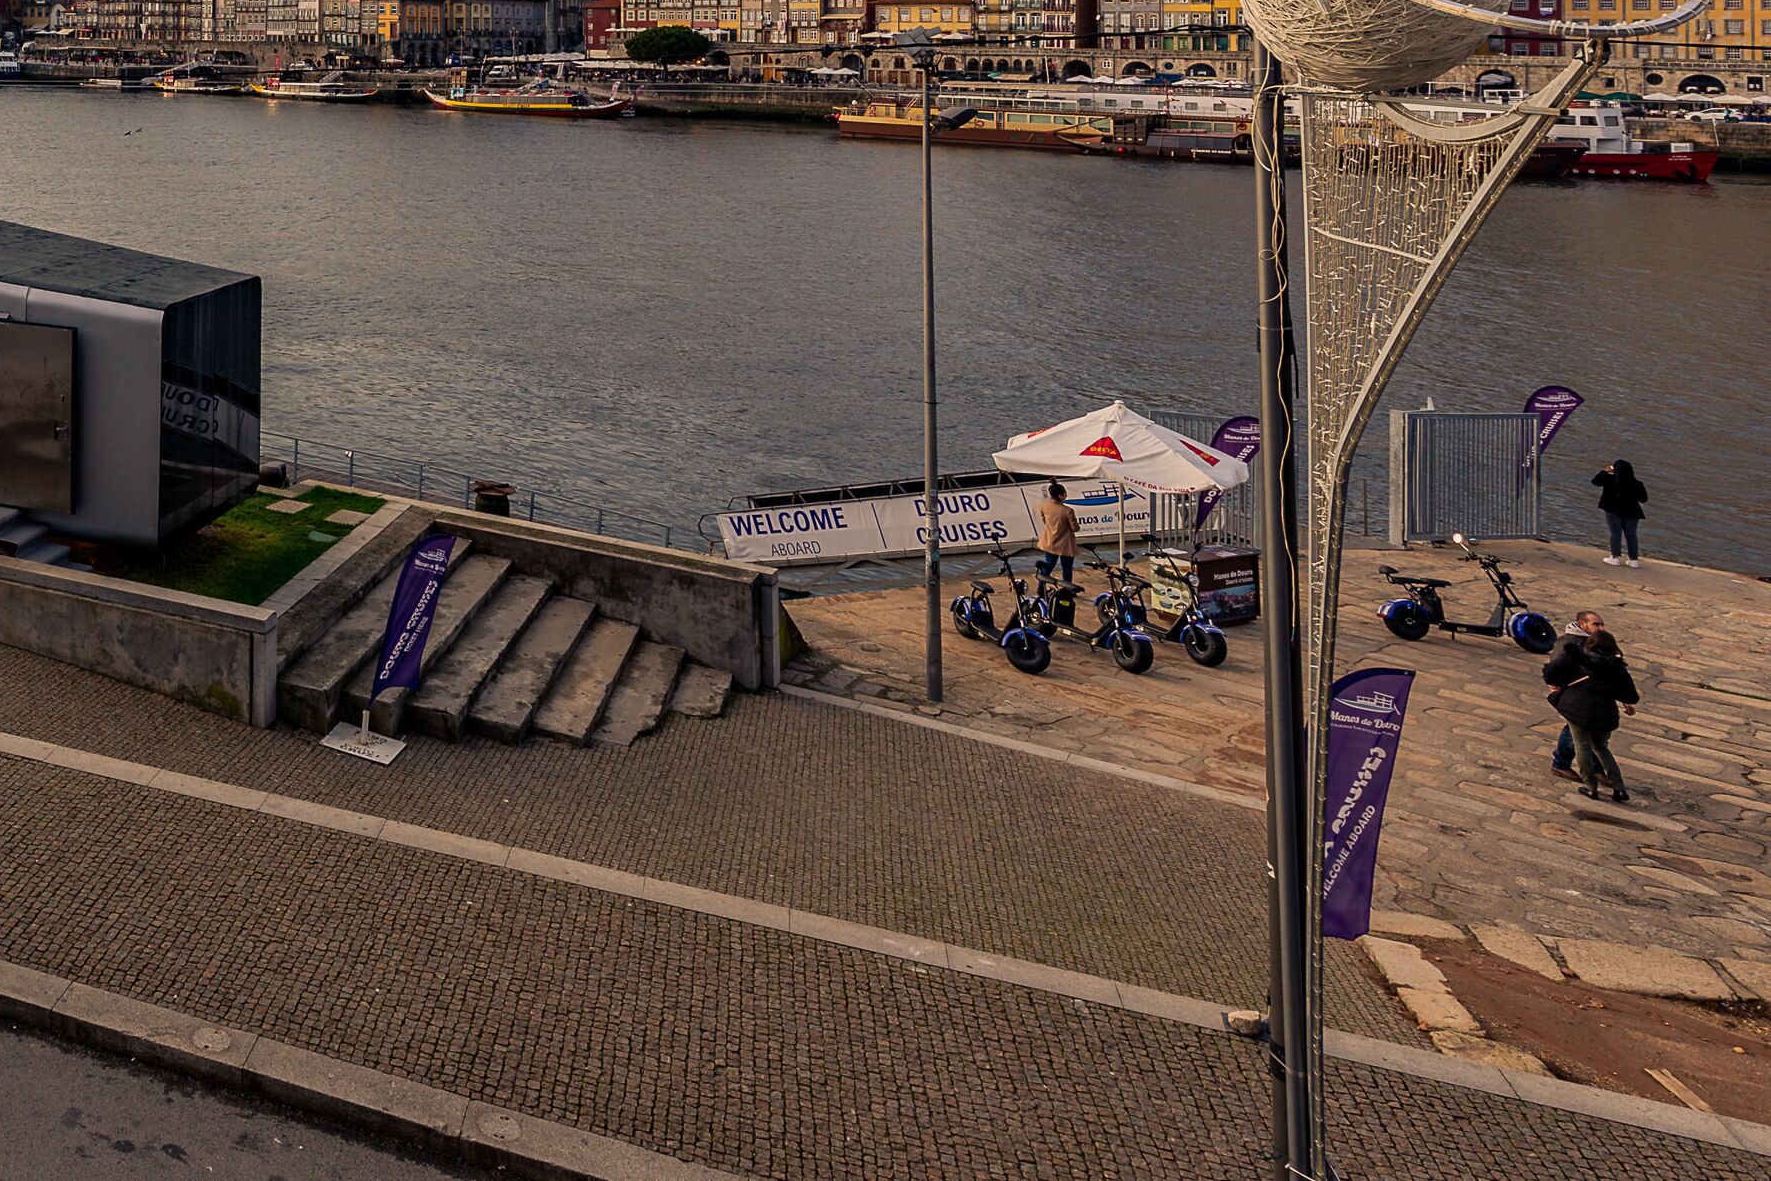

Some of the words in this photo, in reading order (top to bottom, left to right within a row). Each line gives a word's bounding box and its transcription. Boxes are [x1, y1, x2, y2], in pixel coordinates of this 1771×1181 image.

[1540, 411, 1565, 439] CRUISES
[1089, 446, 1117, 455] DELTA
[1130, 478, 1147, 487] CAFÉ
[1148, 483, 1157, 491] DA
[729, 507, 848, 537] WELCOME
[1076, 515, 1099, 525] nos
[1101, 515, 1113, 523] do
[1115, 511, 1150, 522] our
[771, 540, 822, 557] ABOARD
[415, 616, 429, 633] HERE
[1345, 804, 1376, 850] ABOARD
